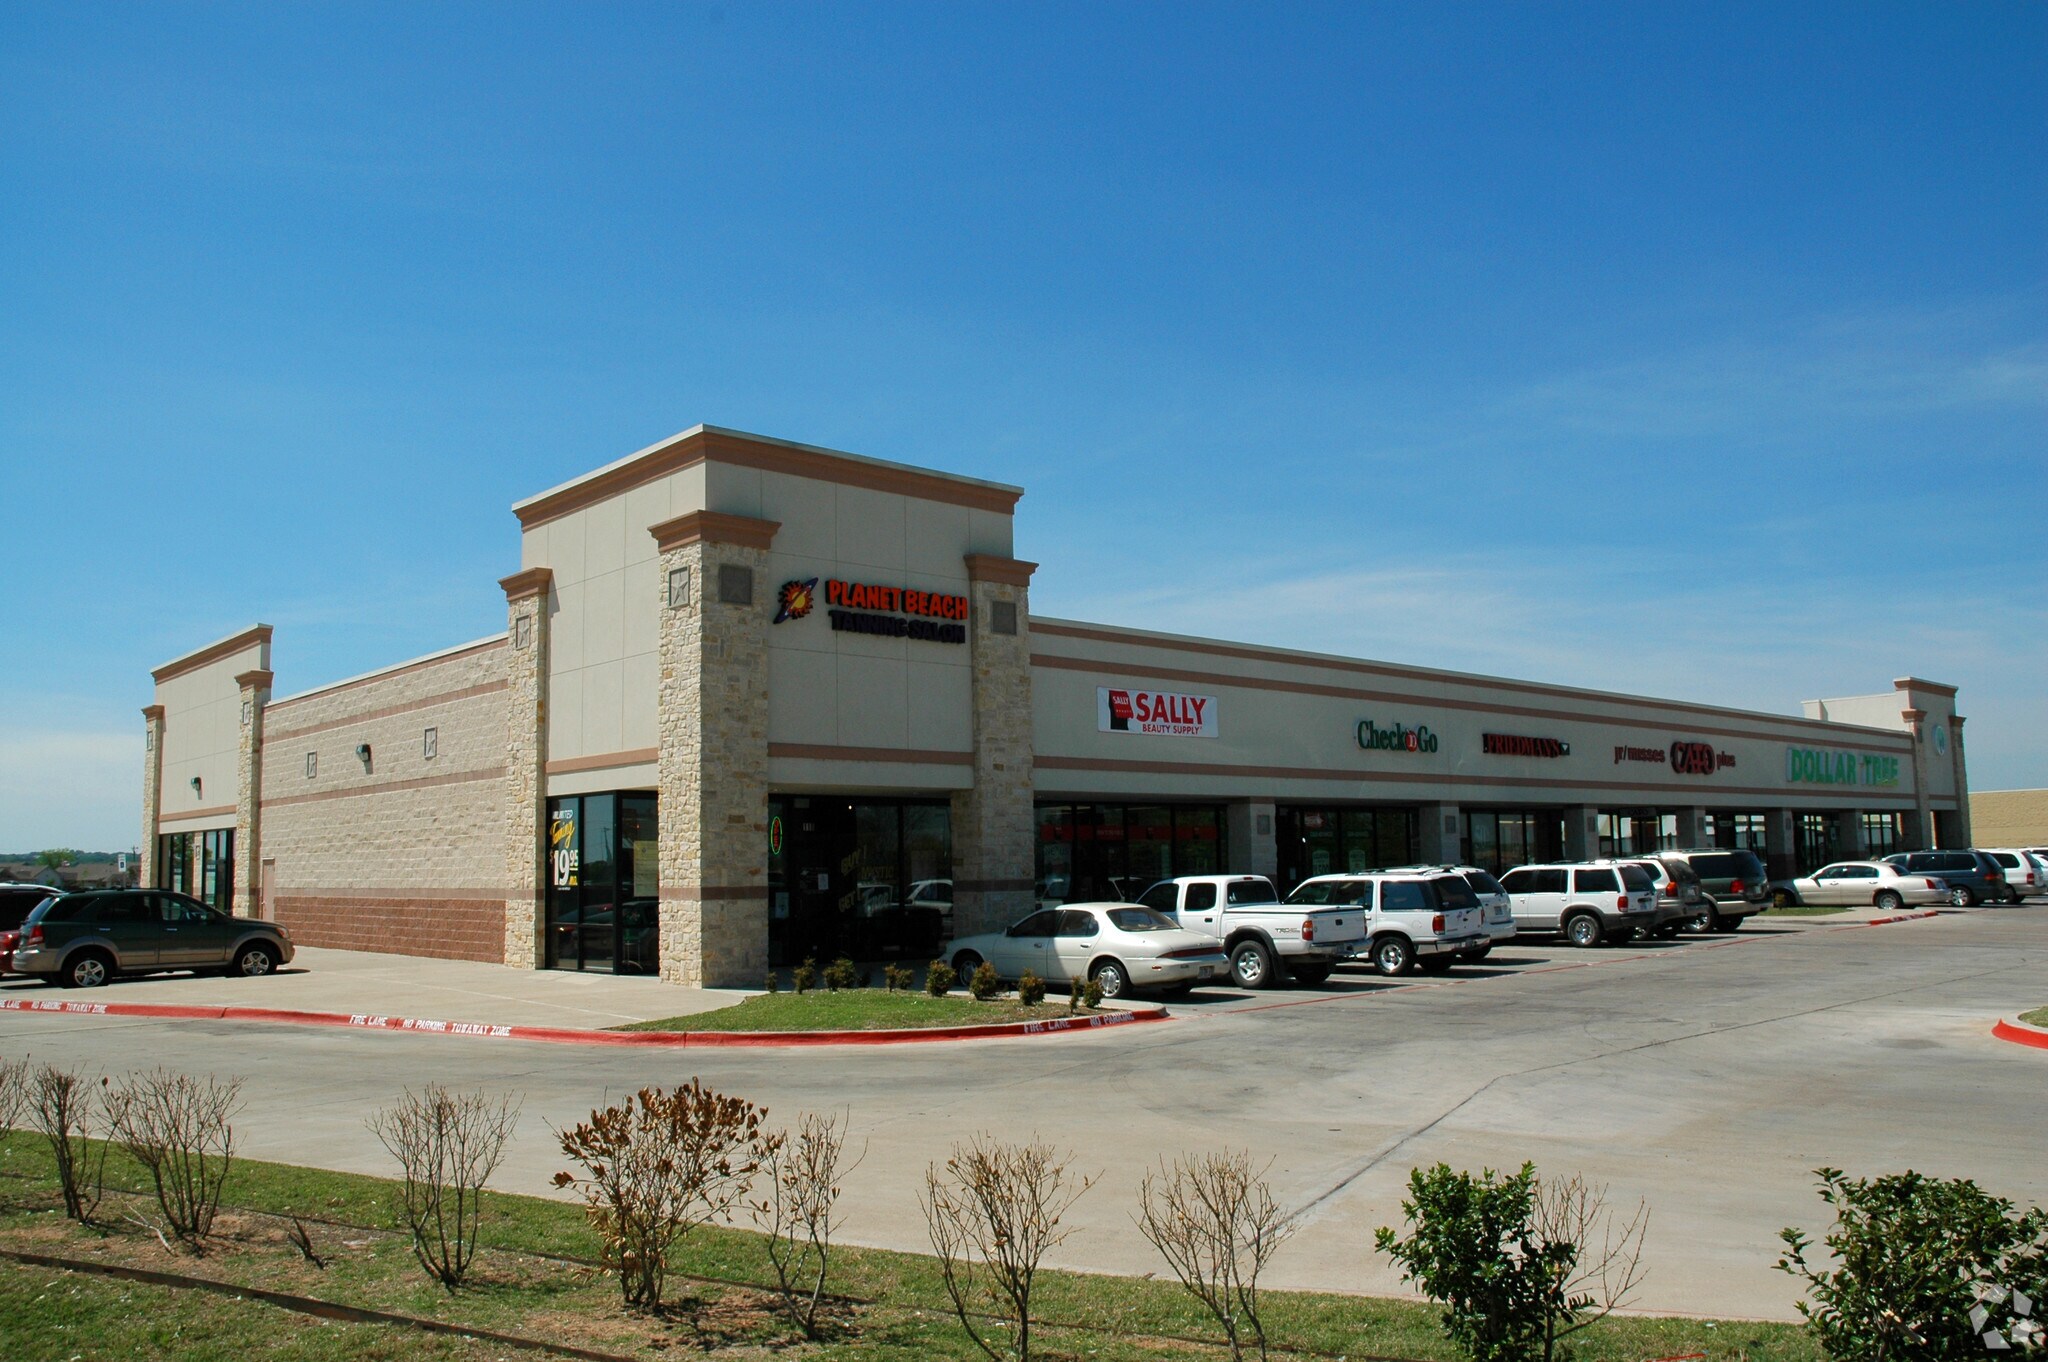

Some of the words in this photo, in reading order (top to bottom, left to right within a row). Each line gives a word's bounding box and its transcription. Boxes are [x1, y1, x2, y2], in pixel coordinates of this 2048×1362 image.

[827, 579, 902, 612] PLANET
[903, 590, 968, 620] BEACH
[829, 611, 908, 637] TANNING
[908, 620, 966, 644] SALON
[1112, 696, 1129, 704] SALLY
[1136, 693, 1207, 725] SALLY
[1142, 724, 1171, 734] BEAUTY
[1173, 726, 1200, 735] SUPPLY
[1357, 720, 1407, 752] Check
[1417, 726, 1438, 753] Go
[1670, 741, 1716, 775] CATO
[1717, 751, 1736, 770] plus
[1788, 748, 1857, 785] DOLLAR
[1861, 755, 1899, 786] TREE
[349, 1014, 366, 1024] FIRE
[367, 1016, 388, 1026] LANE
[402, 1018, 414, 1028] NO
[415, 1019, 446, 1031] PARKING
[489, 1025, 512, 1037] ZONE
[1023, 1022, 1045, 1034] FIRE
[1048, 1019, 1071, 1031] LANE
[1090, 1015, 1101, 1027] NO
[1104, 1010, 1135, 1024] PARKING
